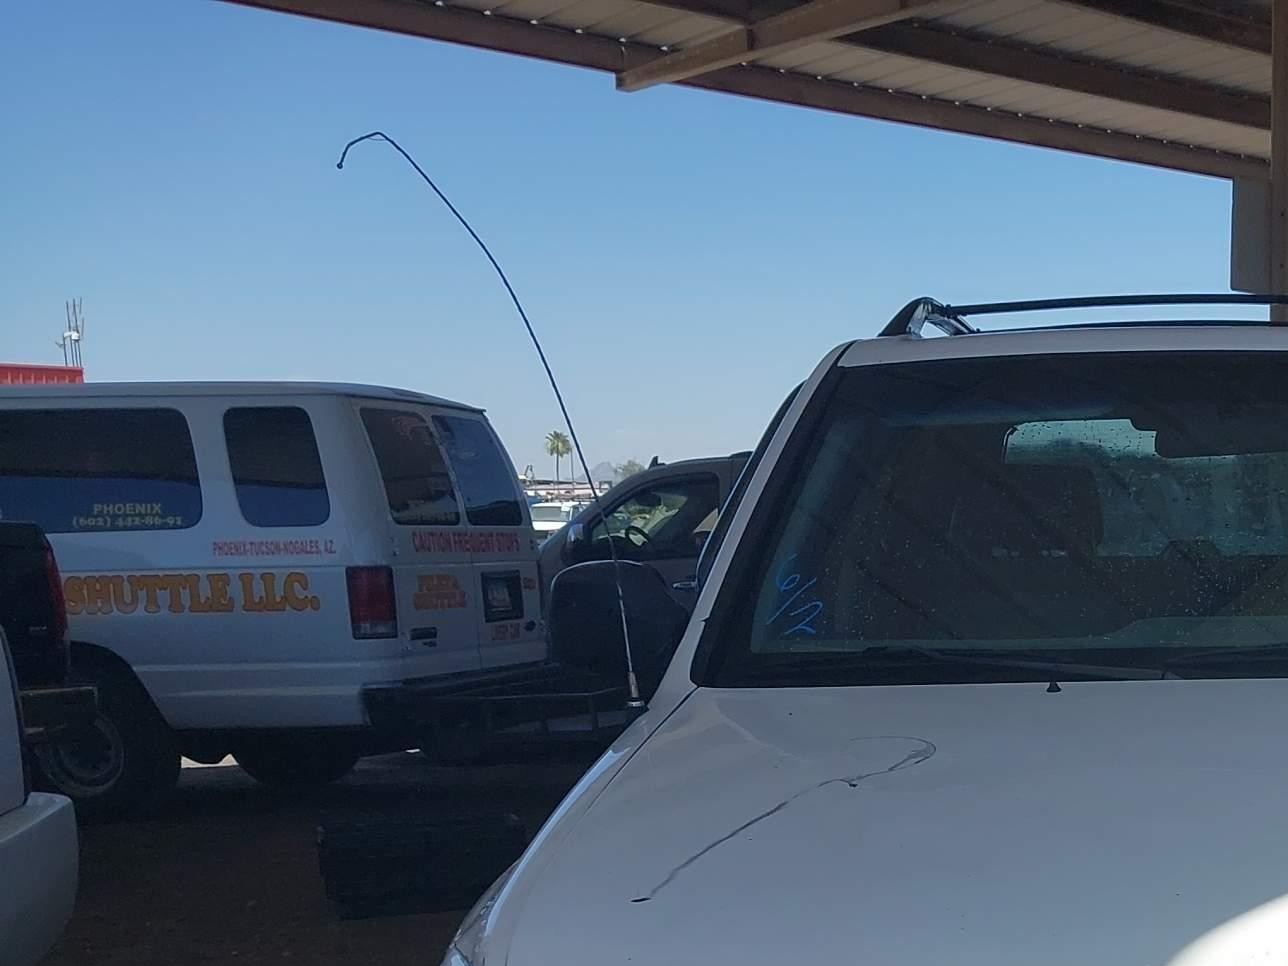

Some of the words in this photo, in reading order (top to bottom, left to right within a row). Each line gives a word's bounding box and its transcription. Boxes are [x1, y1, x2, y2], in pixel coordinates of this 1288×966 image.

[93, 503, 162, 515] PHOENIX
[72, 515, 112, 528] (602)
[412, 531, 451, 552] CAUTION
[452, 531, 493, 552] FREQUENT
[495, 531, 521, 552] STOPS
[63, 572, 234, 615] SHUTTLE
[238, 571, 321, 612] LLC.
